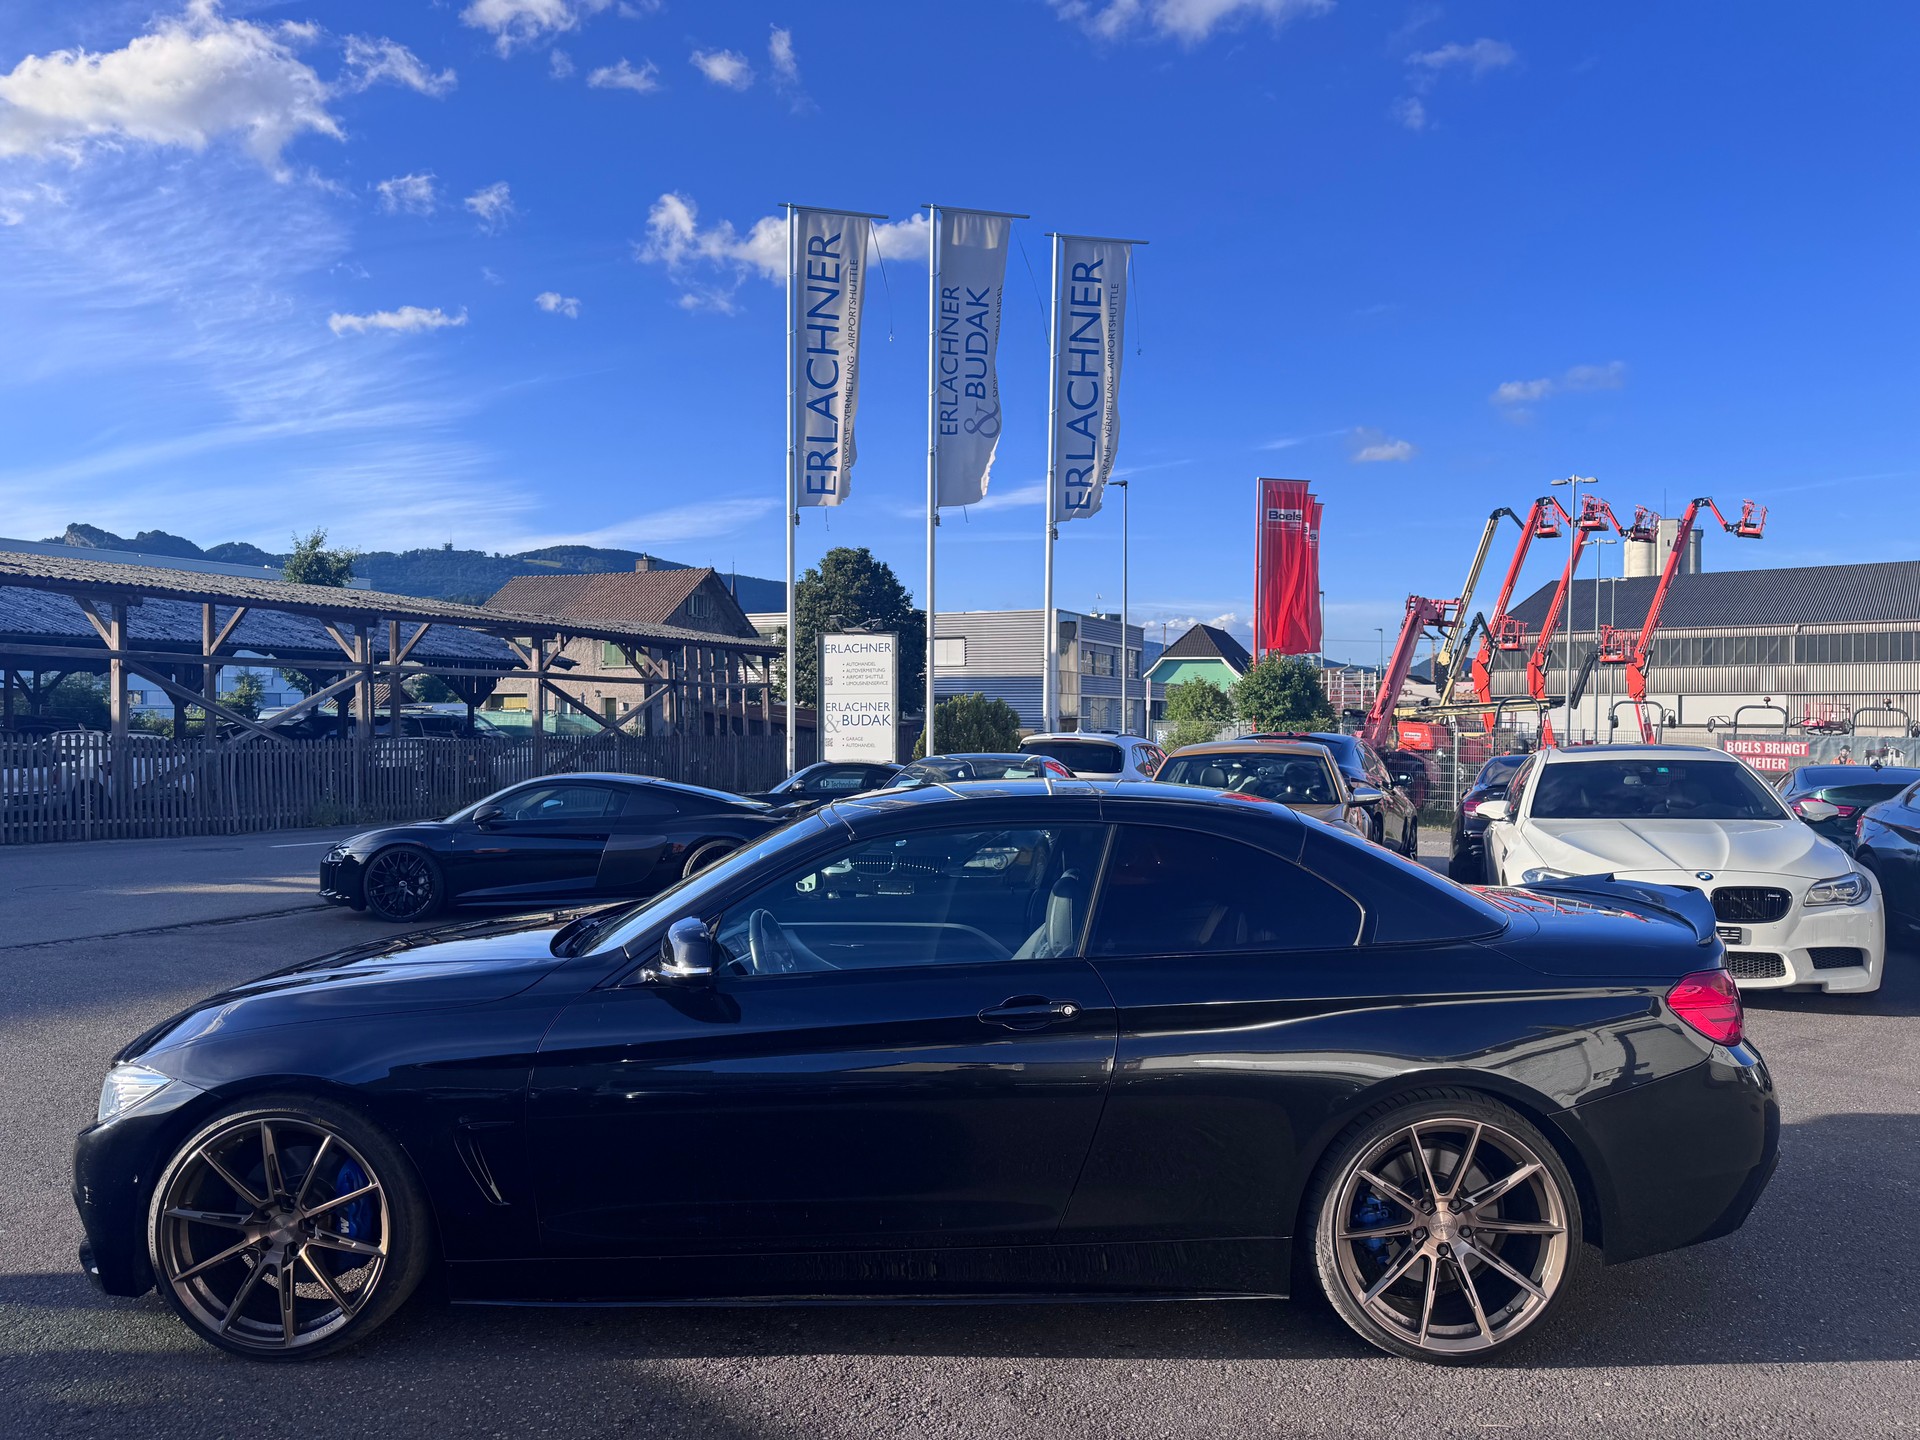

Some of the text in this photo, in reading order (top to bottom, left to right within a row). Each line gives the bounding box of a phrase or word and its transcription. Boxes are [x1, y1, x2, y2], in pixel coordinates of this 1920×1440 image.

[846, 259, 859, 350] AIRPORTSHUTTLE
[1107, 283, 1120, 370] AIRPORTSHUTTLE
[806, 232, 842, 495] ERLACHNER
[844, 355, 855, 421] VERMIETUNG
[940, 286, 959, 436] ERLACHNER
[963, 286, 1002, 439] & BUDAK
[1065, 258, 1103, 511] ERLACHNER
[1104, 376, 1115, 439] VERMIETUNG
[1268, 510, 1302, 521] Boels
[825, 642, 892, 654] ERLACHNER
[825, 702, 891, 712] ERLACHNER
[825, 713, 891, 733] & BUDAK
[1726, 741, 1807, 755] BOELS BRINGT
[1746, 757, 1787, 770] WEITER
